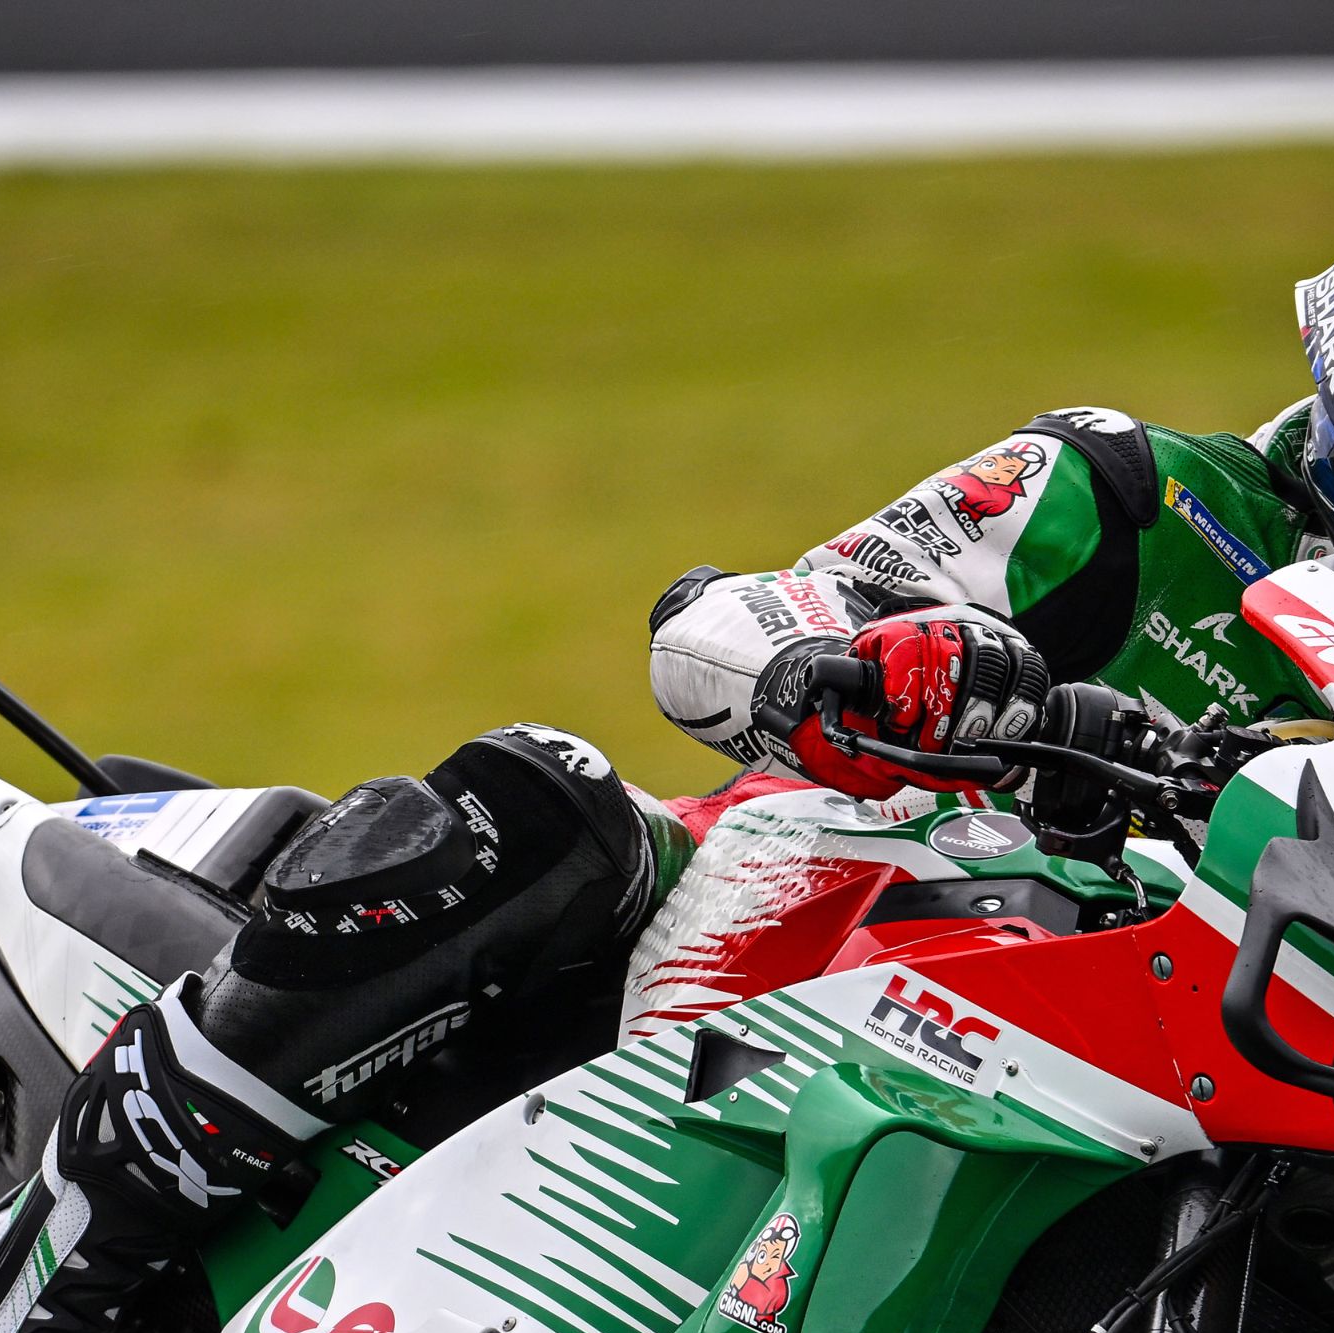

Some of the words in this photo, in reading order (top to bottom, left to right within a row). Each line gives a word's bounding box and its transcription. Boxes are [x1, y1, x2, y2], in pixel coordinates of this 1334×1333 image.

[1306, 289, 1317, 327] HELMETS
[1193, 511, 1258, 577] MICHELIN
[731, 583, 806, 647] POWER1
[1145, 611, 1260, 717] SHARK
[940, 835, 999, 854] HONDA
[864, 1019, 915, 1054] Honda
[916, 1047, 976, 1085] RACING
[869, 974, 1002, 1071] HRC
[115, 1028, 242, 1208] TCX
[232, 1147, 271, 1171] RT-RACE
